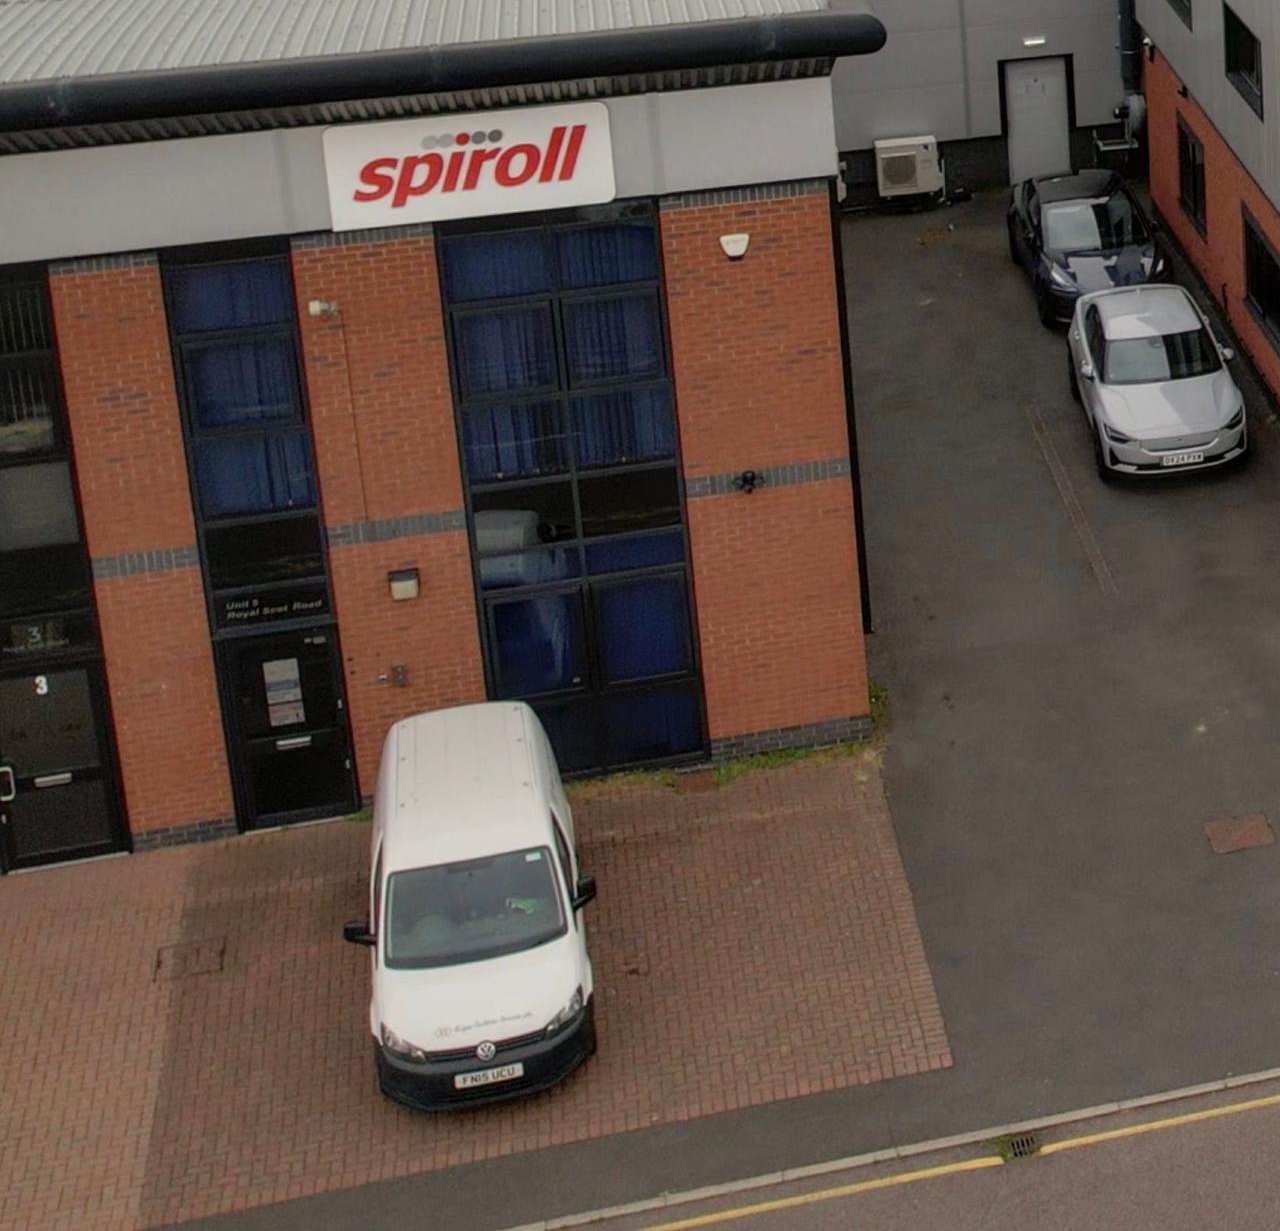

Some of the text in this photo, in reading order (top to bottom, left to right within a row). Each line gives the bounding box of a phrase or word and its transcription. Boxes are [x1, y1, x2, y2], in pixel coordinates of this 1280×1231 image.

[353, 124, 587, 208] spiroll
[226, 601, 249, 610] Unit
[227, 608, 260, 619] Royal
[292, 599, 322, 610] Road
[28, 627, 41, 642] 3
[35, 675, 48, 695] 3
[462, 1067, 515, 1085] FN15 UCU
